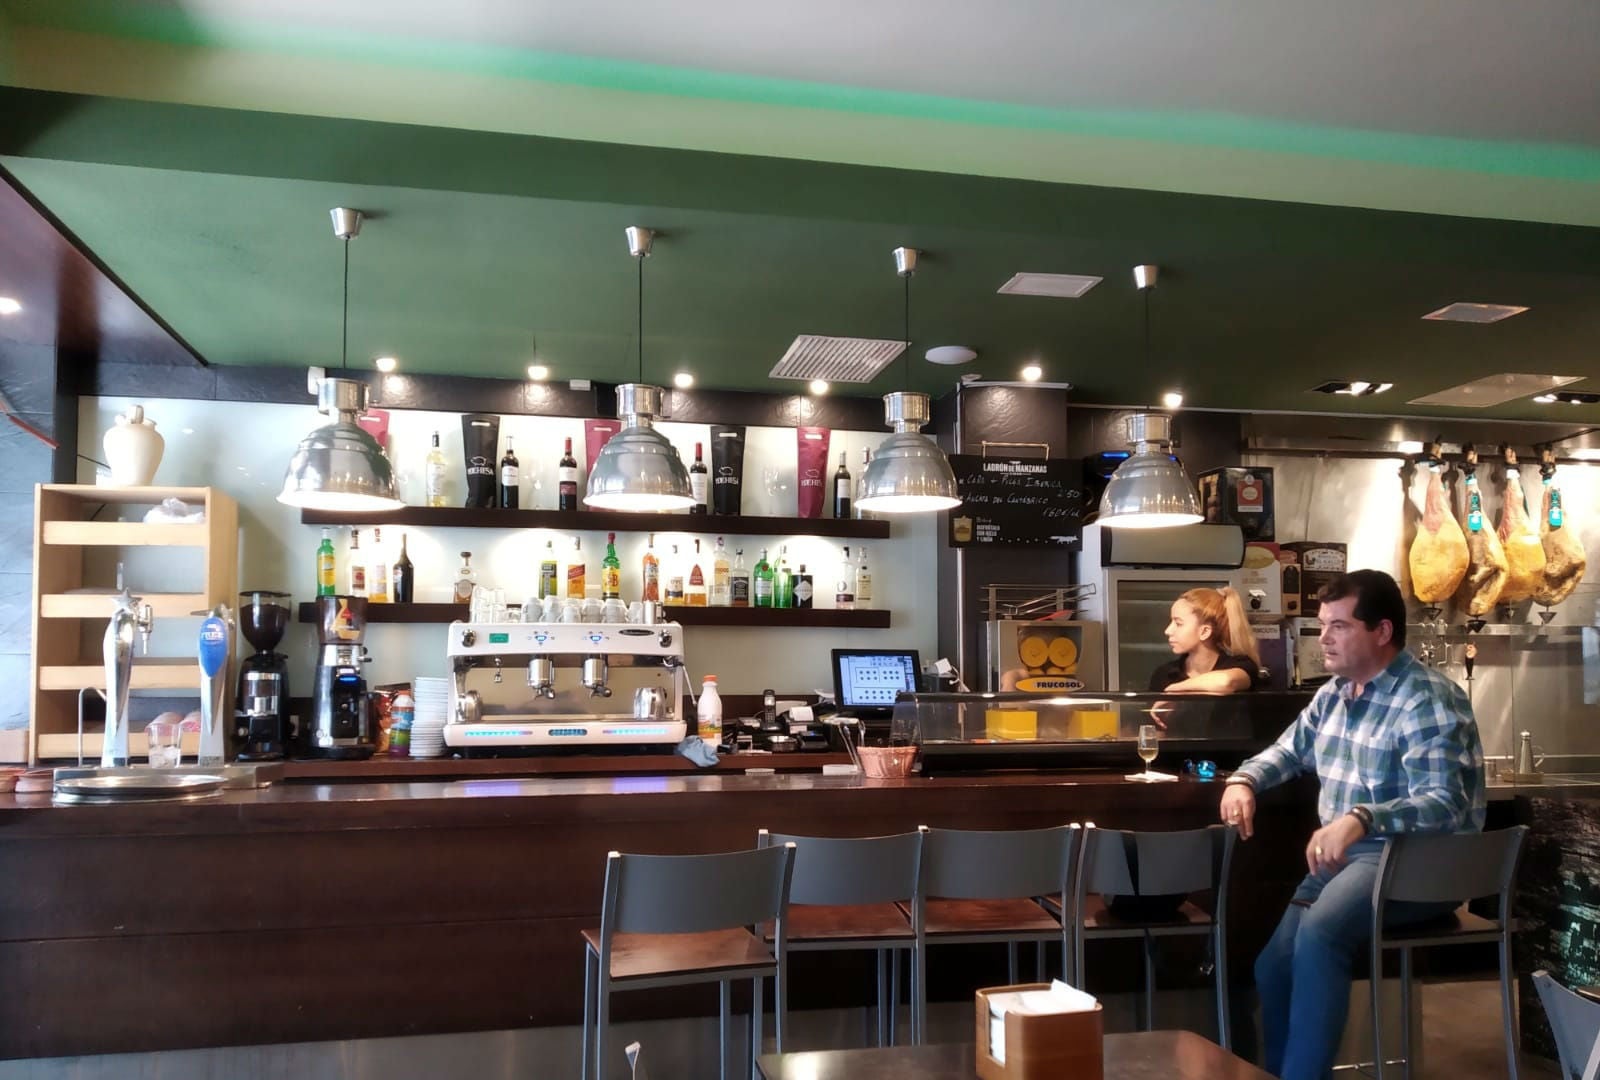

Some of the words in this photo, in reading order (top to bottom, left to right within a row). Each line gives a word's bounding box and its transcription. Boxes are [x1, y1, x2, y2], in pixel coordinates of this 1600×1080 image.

[983, 462, 1008, 472] LADRÓN
[1015, 463, 1048, 473] MANZANAS
[1036, 681, 1081, 689] FRUCOSOL
